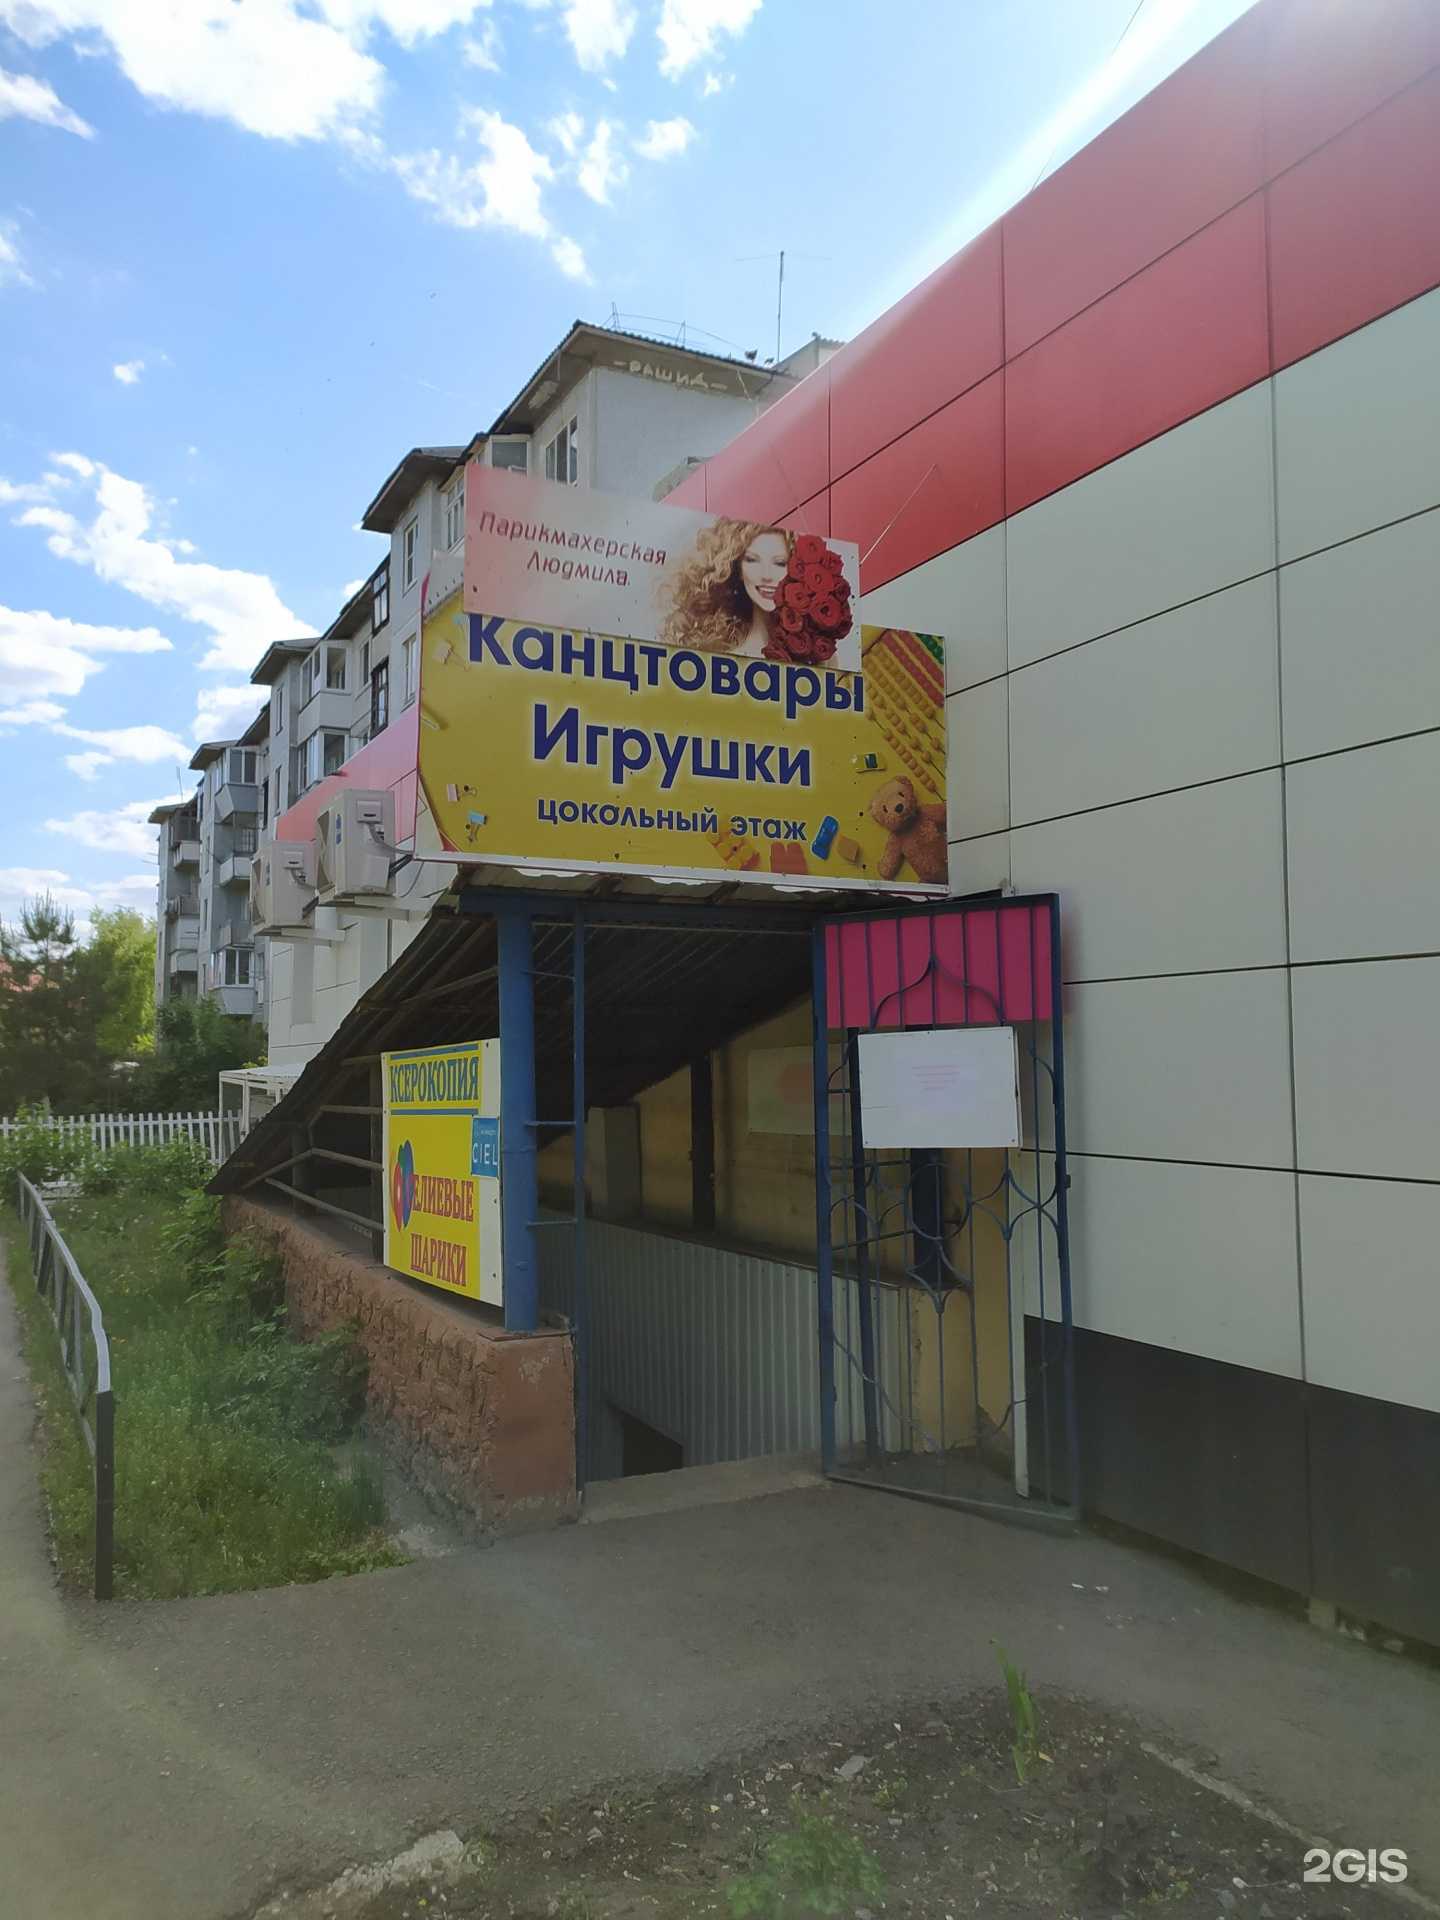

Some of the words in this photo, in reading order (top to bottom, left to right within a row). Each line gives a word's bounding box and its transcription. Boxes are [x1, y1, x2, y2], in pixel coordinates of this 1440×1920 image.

[479, 511, 667, 566] Парикмахерская
[526, 551, 629, 586] Людмила
[469, 614, 864, 720] Канцтовары
[533, 703, 811, 789] Игрушки
[537, 799, 718, 834] цокольный
[730, 815, 807, 841] этаж
[390, 1056, 479, 1103] КСЕРОКОПИЯ
[473, 1142, 498, 1166] CIEL
[411, 1232, 467, 1287] ШАРИКИ
